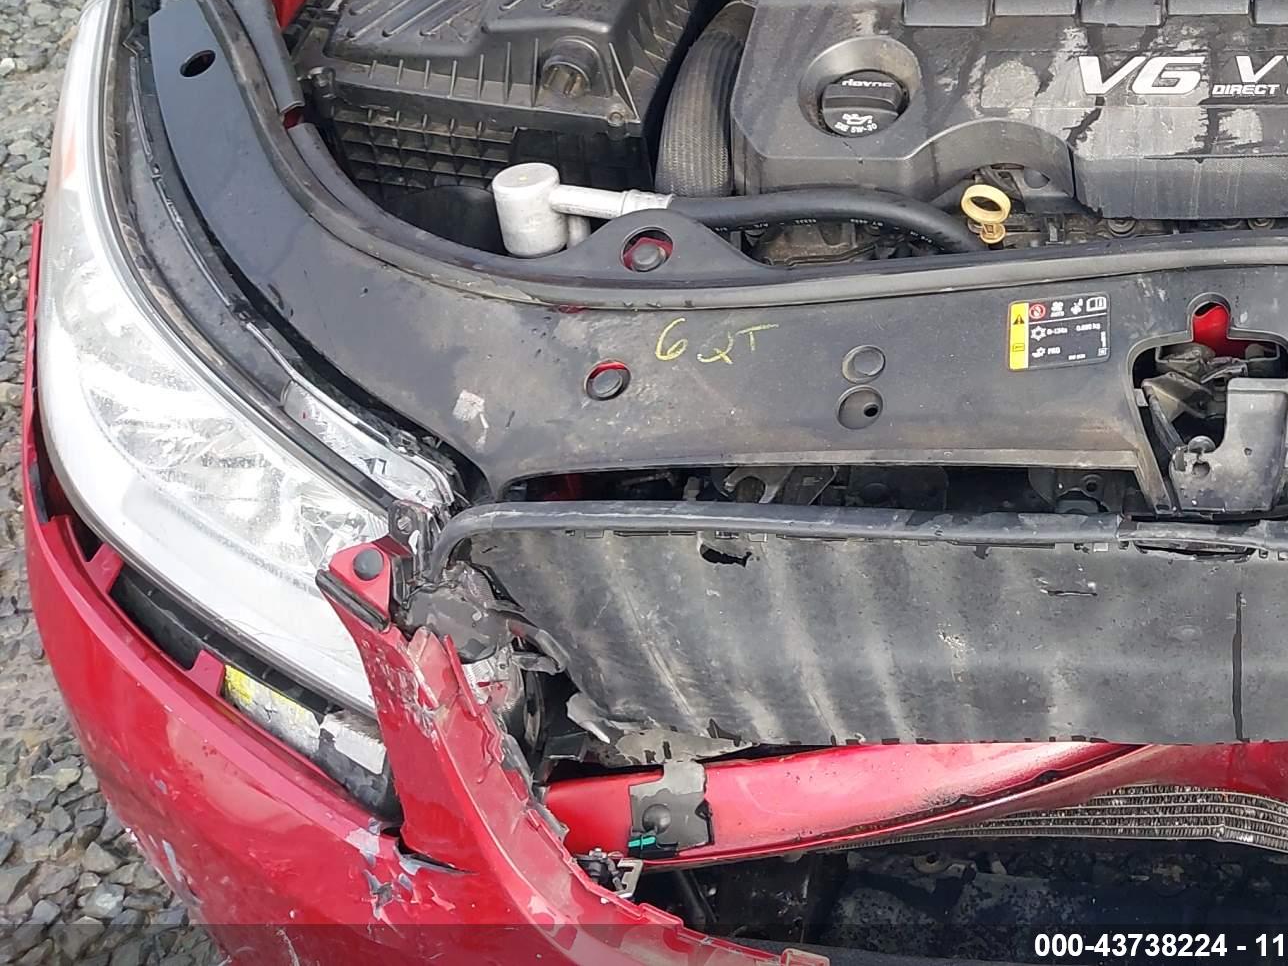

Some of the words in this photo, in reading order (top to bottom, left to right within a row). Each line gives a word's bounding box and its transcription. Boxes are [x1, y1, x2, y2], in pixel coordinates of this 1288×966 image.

[1079, 56, 1205, 94] V6
[1212, 84, 1280, 95] DIRECT
[850, 122, 878, 134] 5W-30
[655, 317, 688, 361] 6
